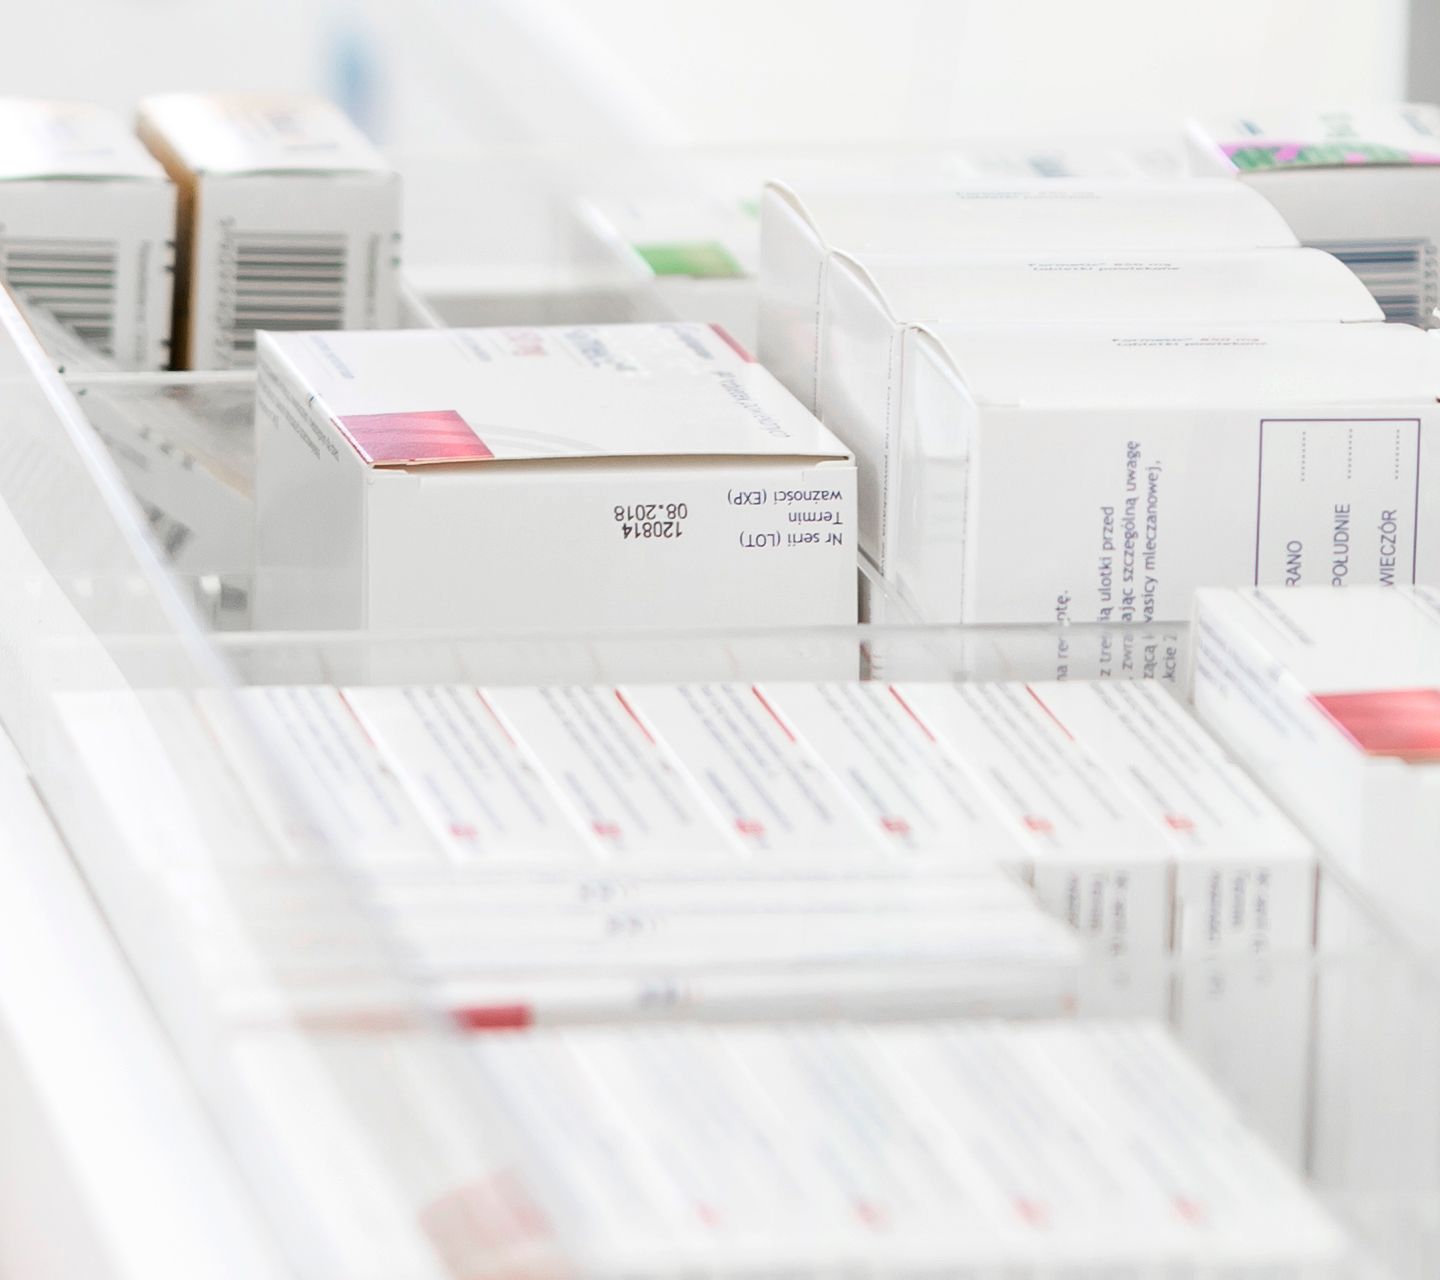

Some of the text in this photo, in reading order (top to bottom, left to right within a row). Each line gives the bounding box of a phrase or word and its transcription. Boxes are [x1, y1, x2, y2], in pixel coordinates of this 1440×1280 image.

[613, 503, 688, 521] 08.2018
[727, 488, 843, 506] ważności (EXP)
[788, 511, 843, 525] Termin
[1143, 459, 1162, 571] mleczanowej,
[622, 521, 683, 539] 120814
[739, 531, 843, 549] Nr serii (LOT)
[1100, 506, 1116, 551] przed
[1332, 503, 1351, 586] POŁUDNIE
[1378, 509, 1398, 586] WIECZÓR
[1121, 440, 1141, 670] zwraając szczególną uwagę
[1285, 539, 1303, 586] RANO
[1098, 556, 1113, 602] ulotki
[1056, 589, 1071, 659] reptę.
[1099, 606, 1116, 663] treią
[1162, 647, 1176, 682] kcie
